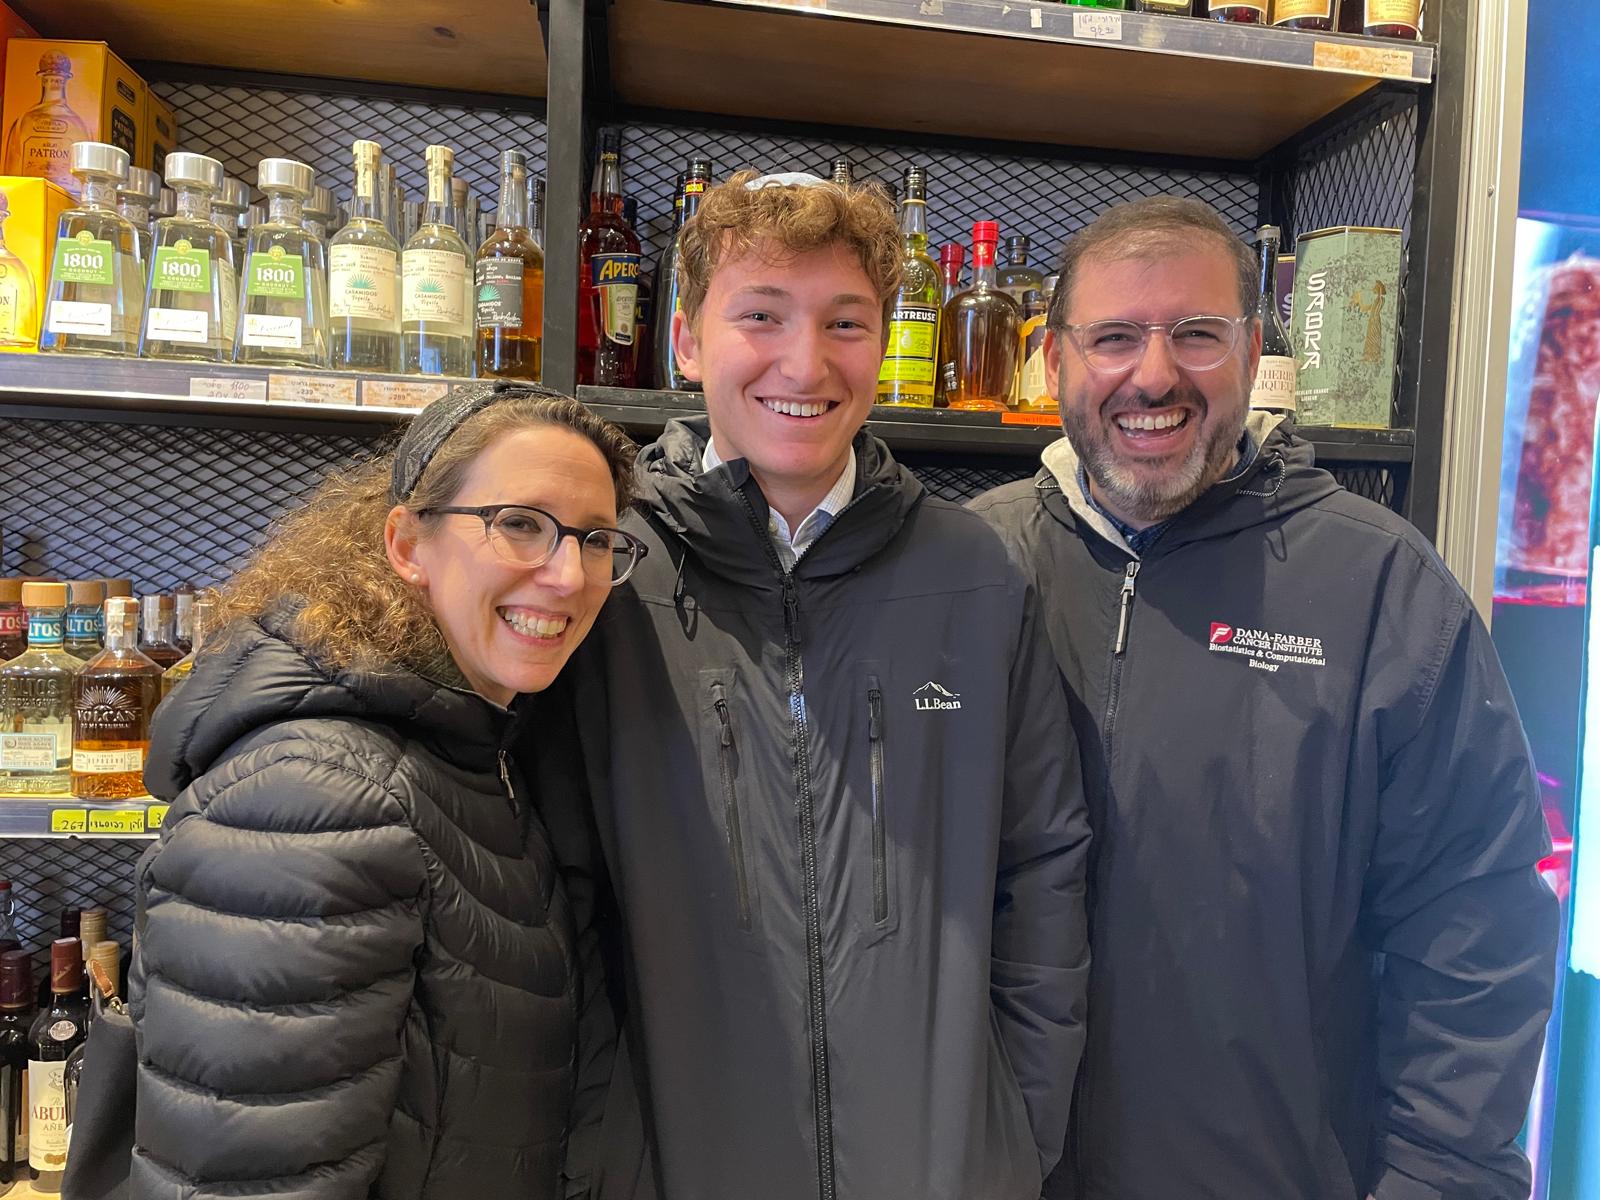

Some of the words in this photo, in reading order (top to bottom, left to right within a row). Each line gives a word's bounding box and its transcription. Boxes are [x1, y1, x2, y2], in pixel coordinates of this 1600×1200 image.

[29, 147, 70, 159] PATRON
[63, 252, 104, 269] 1800
[161, 261, 201, 278] 1800
[256, 267, 295, 284] 1800
[345, 289, 377, 297] CASAMIGOS
[415, 293, 446, 301] CASAMIGOS
[1301, 271, 1328, 370] SABRA
[1236, 628, 1322, 648] DANA-FARBER
[1233, 637, 1271, 650] CANCER
[1272, 642, 1323, 656] INSTITUTE
[1209, 643, 1255, 657] Biostatistics
[1256, 649, 1264, 658] &
[1265, 651, 1326, 666] Computational
[1249, 659, 1279, 672] Biology
[915, 698, 961, 710] L.L.Bean
[77, 709, 137, 722] VOLCAN
[62, 820, 85, 830] 267
